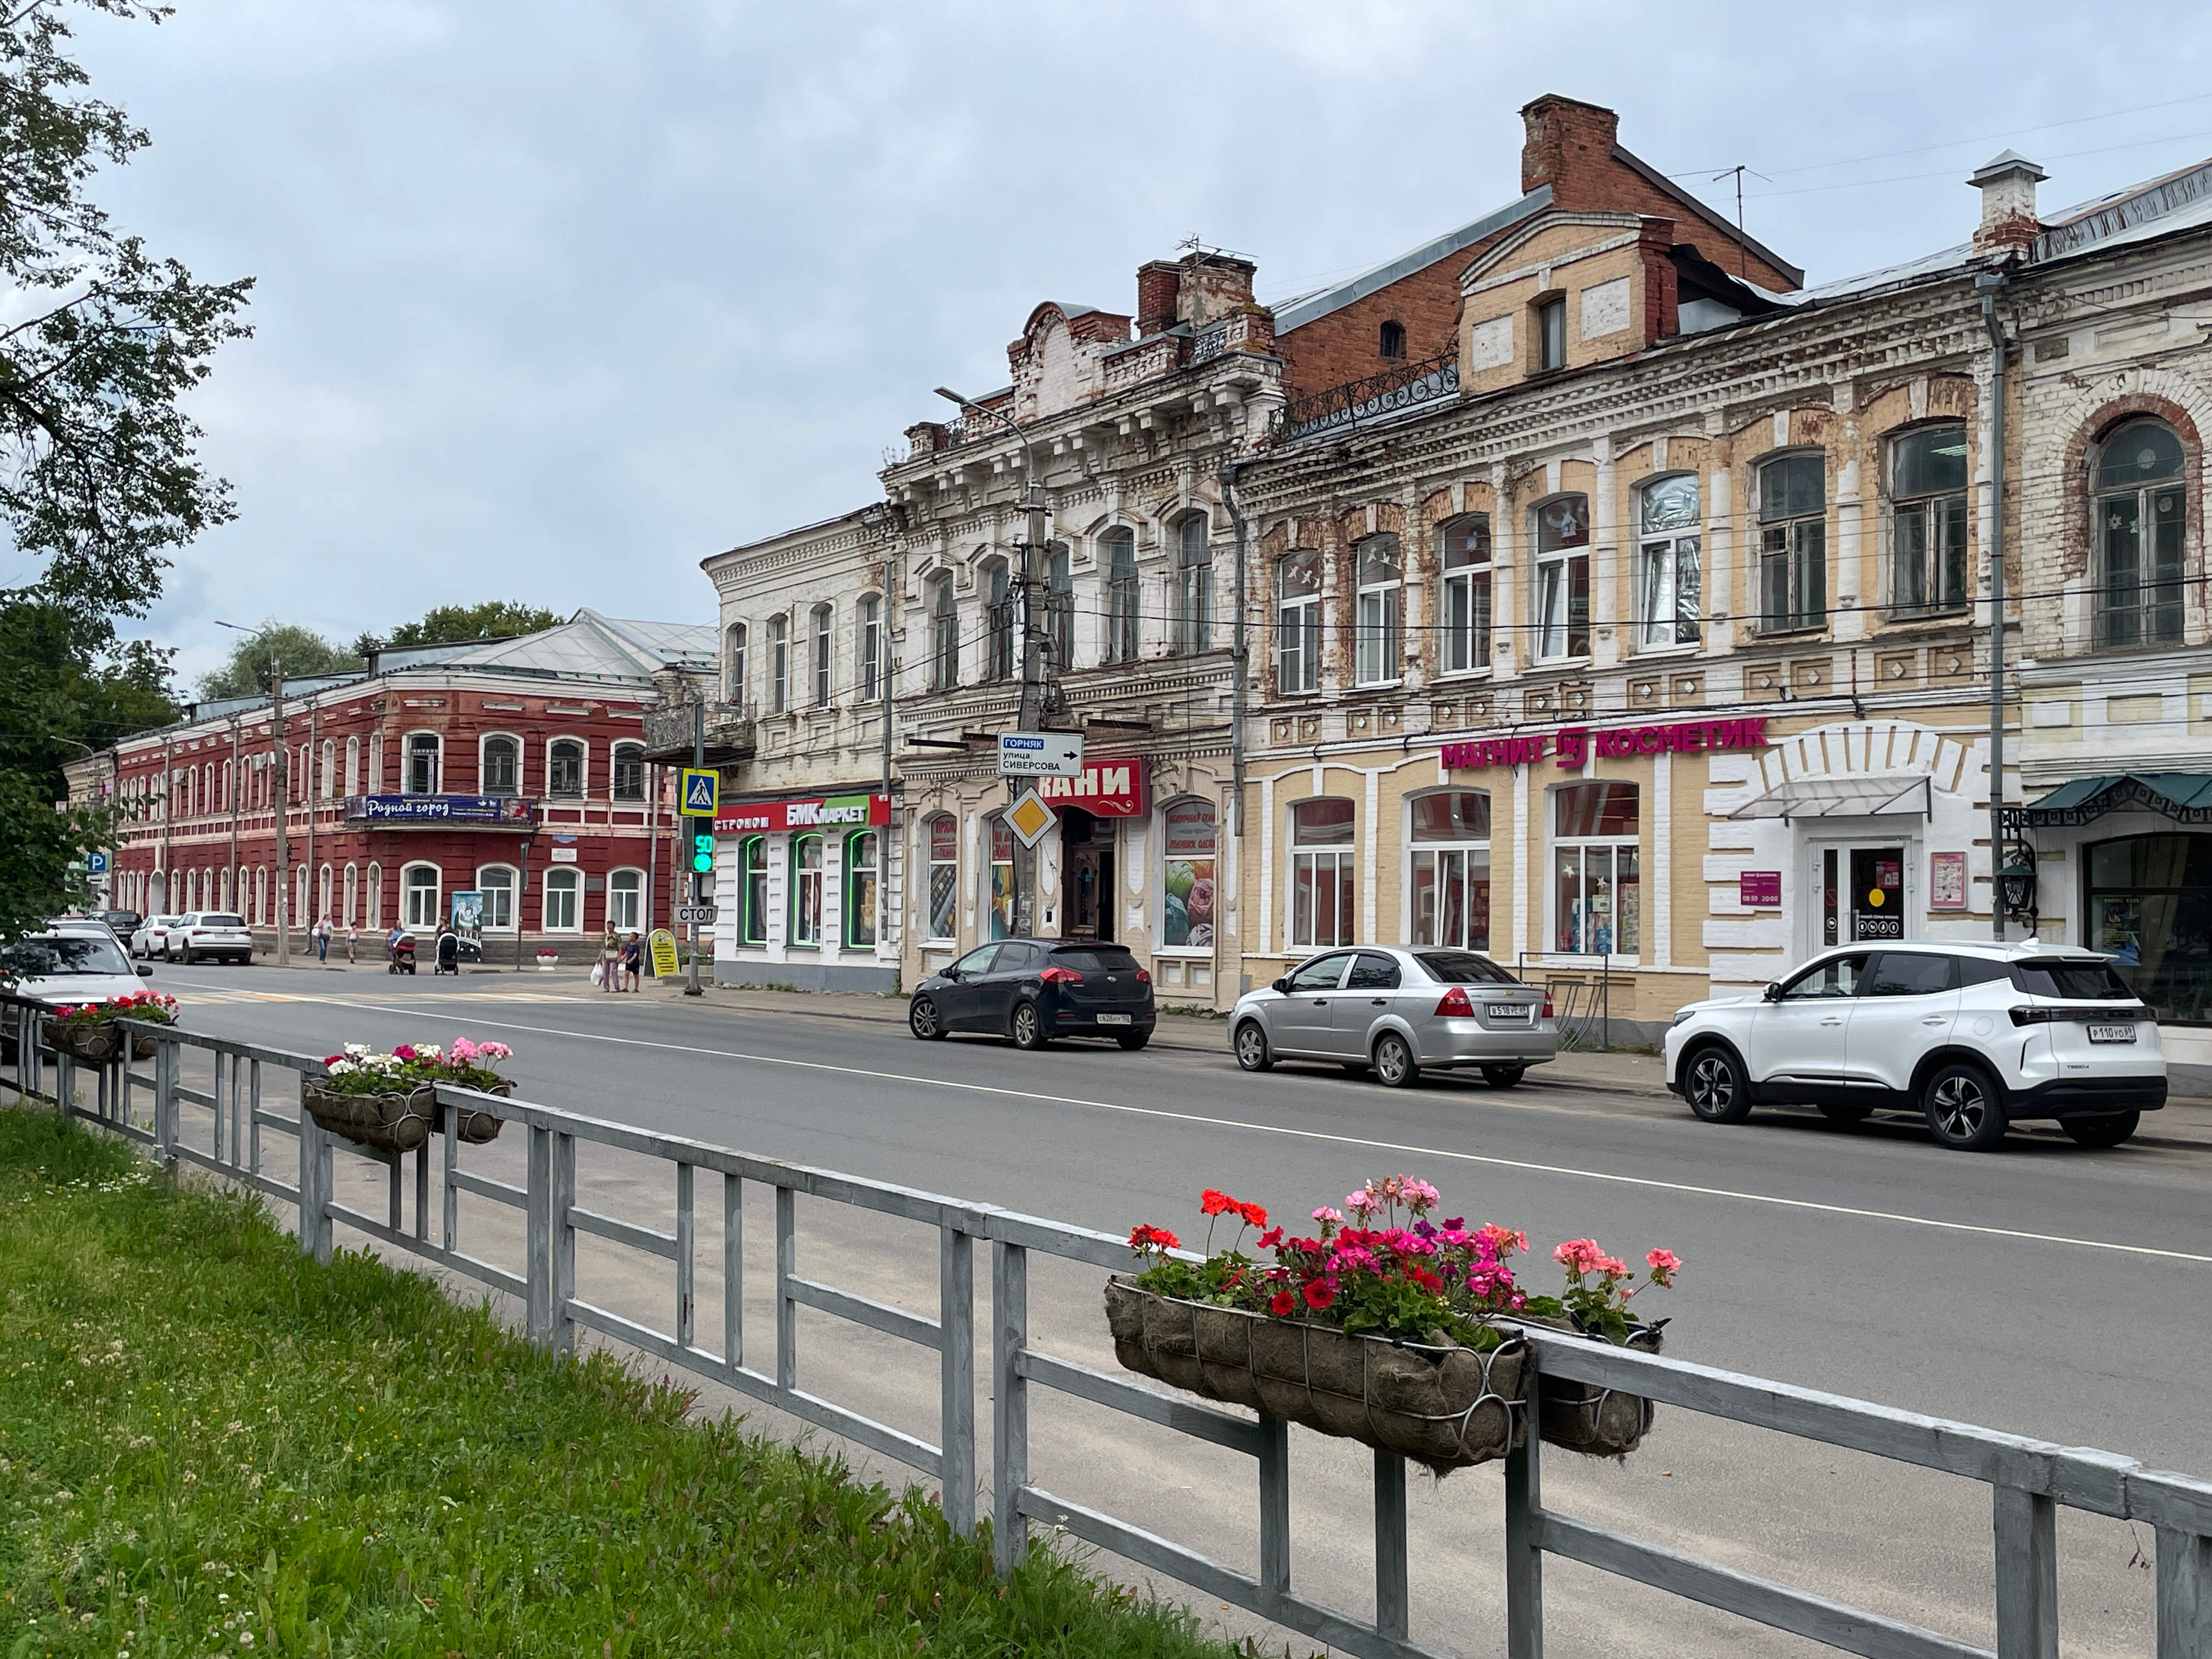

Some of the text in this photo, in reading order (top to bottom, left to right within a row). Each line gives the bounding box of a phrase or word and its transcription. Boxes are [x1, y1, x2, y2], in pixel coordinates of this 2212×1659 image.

[1004, 738, 1043, 749] ГОРНЯК
[1441, 718, 1770, 769] МАГНИТ КОСМЕТИК
[1003, 752, 1030, 760] улица
[1003, 761, 1060, 771] СИВЕРСОВА
[1038, 767, 1131, 798] КАНИ
[367, 800, 449, 816] Родной город
[819, 806, 866, 824] МАРКЕТ
[714, 817, 769, 831] СТРОНОМ
[695, 836, 713, 853] 50
[92, 856, 103, 870] P
[680, 909, 713, 921] СТОП
